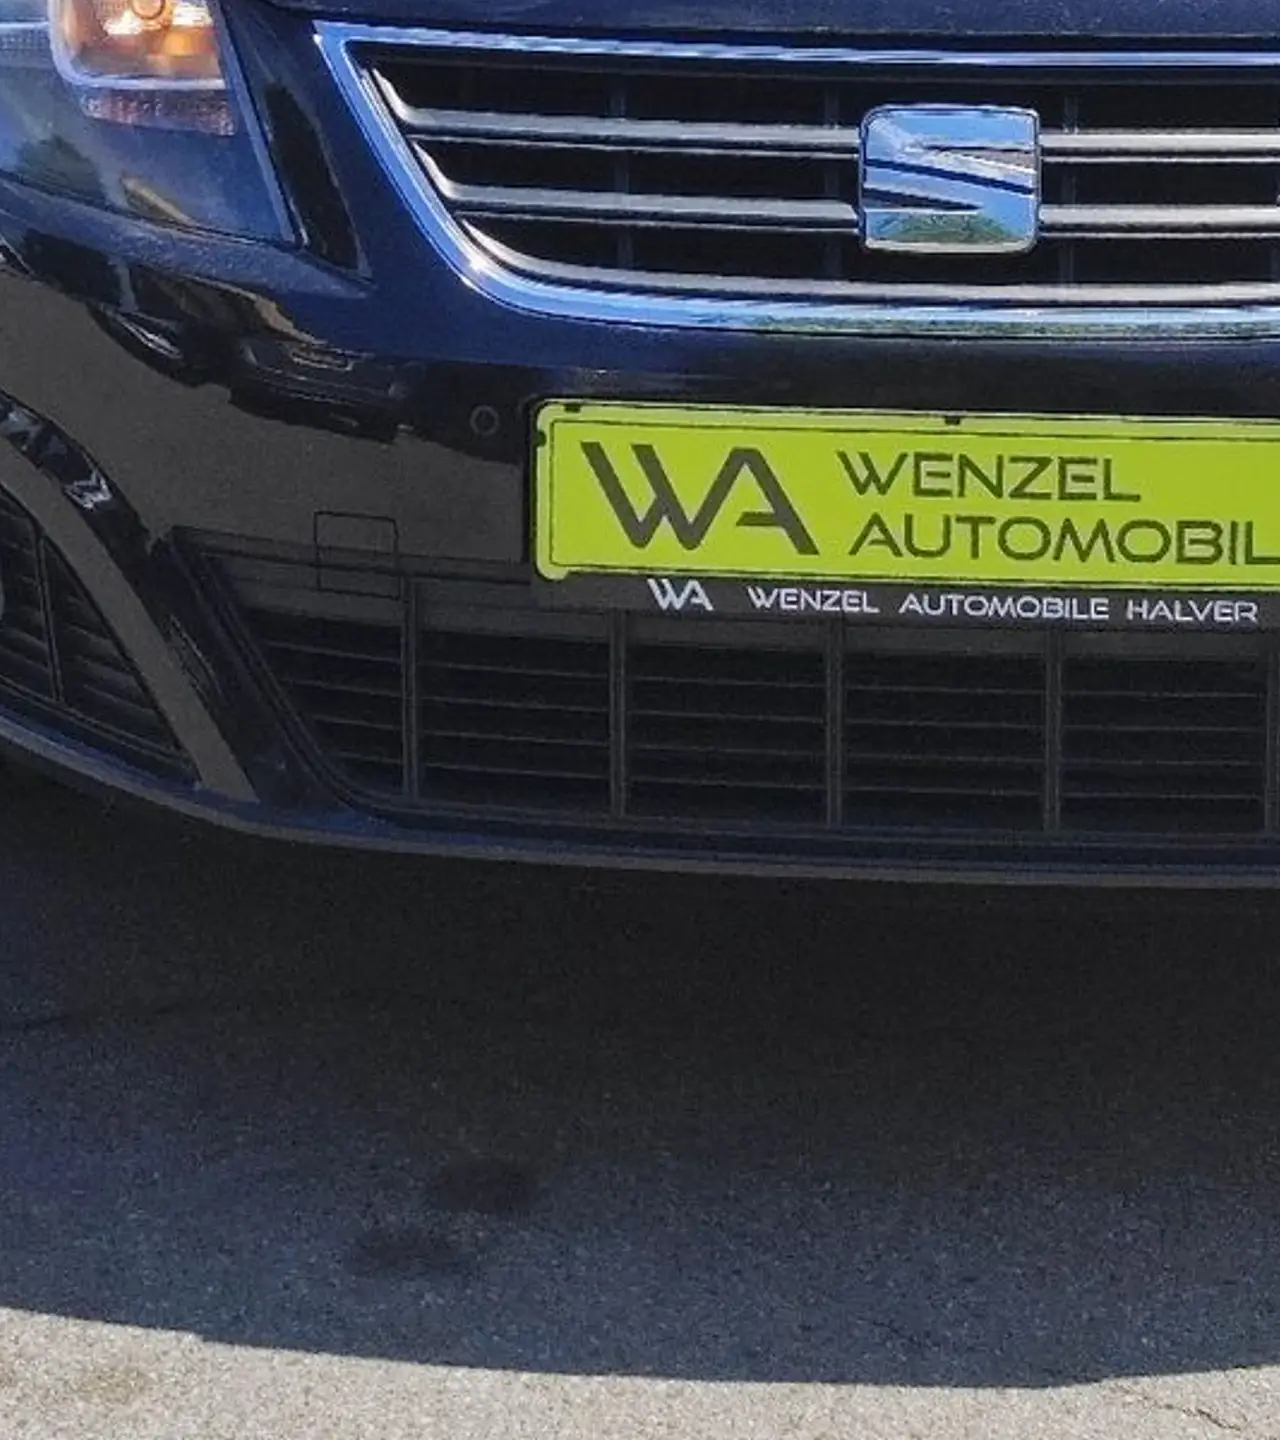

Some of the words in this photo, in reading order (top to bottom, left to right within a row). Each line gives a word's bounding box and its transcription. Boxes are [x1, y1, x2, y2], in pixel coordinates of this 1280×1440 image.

[580, 440, 821, 556] WA
[835, 449, 1141, 503] WENZEL
[646, 577, 715, 612] WA
[746, 586, 881, 614] WENZEL
[898, 593, 1110, 621] AUTOMOBILE
[1126, 598, 1259, 625] HALVER
